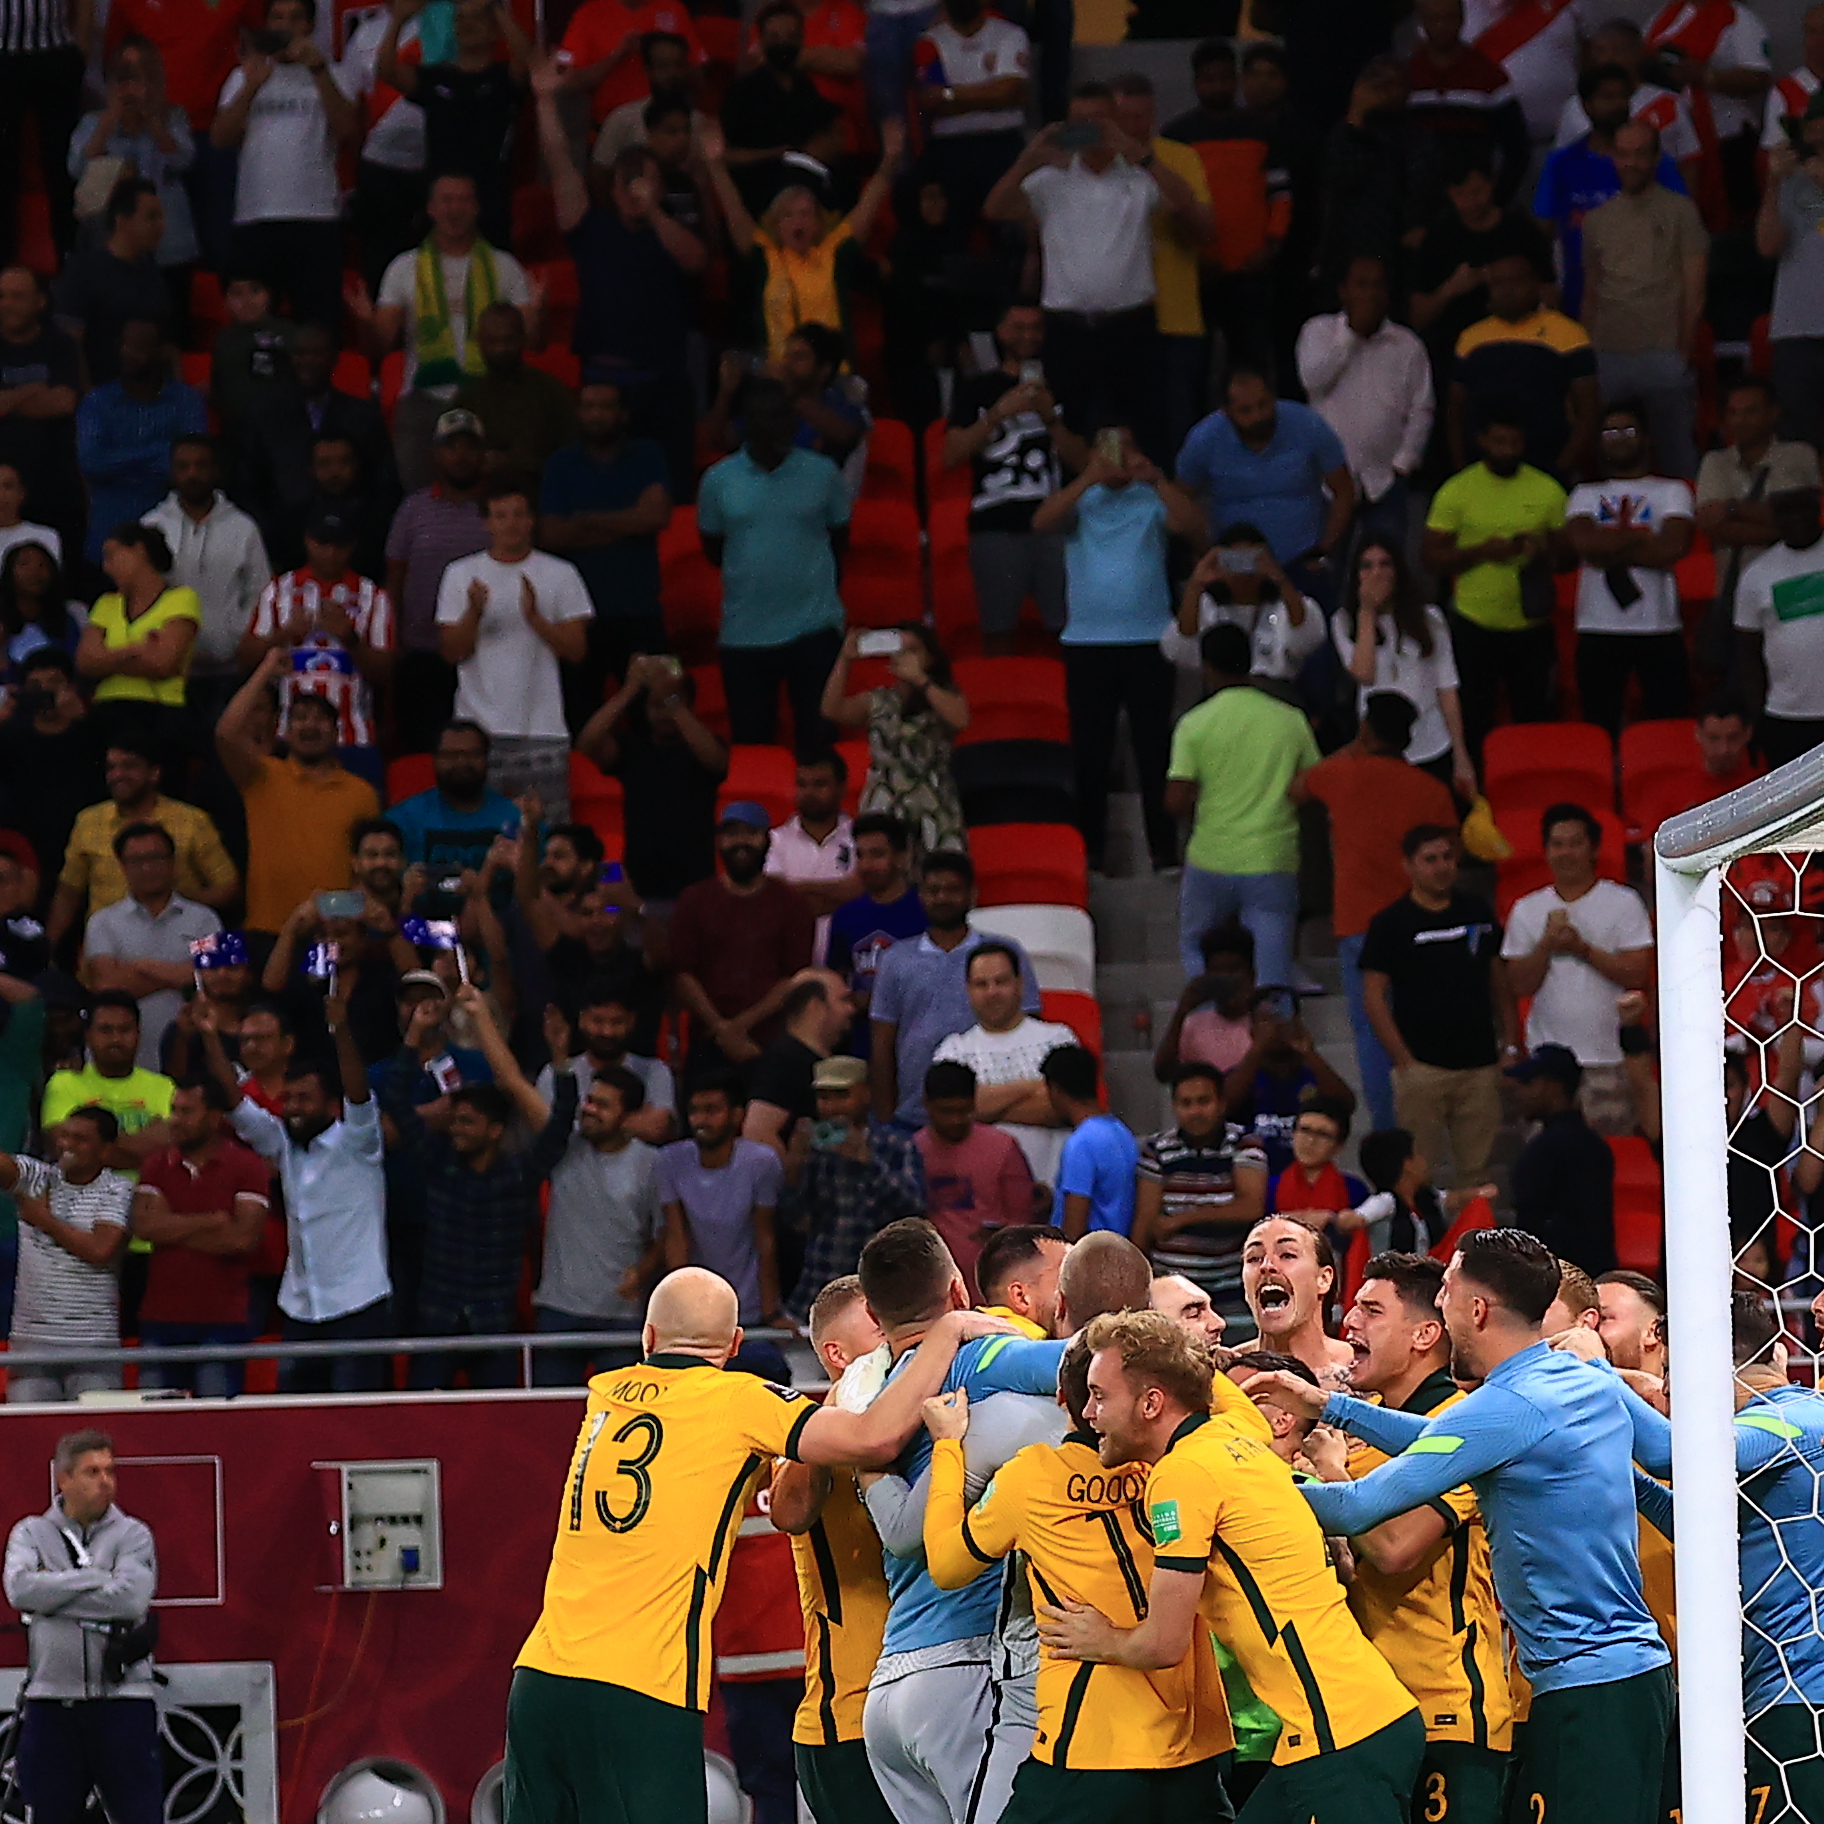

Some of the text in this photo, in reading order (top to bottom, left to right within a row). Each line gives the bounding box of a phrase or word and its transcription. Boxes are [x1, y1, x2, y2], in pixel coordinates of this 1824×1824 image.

[604, 1380, 669, 1402] MOO
[569, 1411, 664, 1534] 13
[1424, 1771, 1449, 1823] 3
